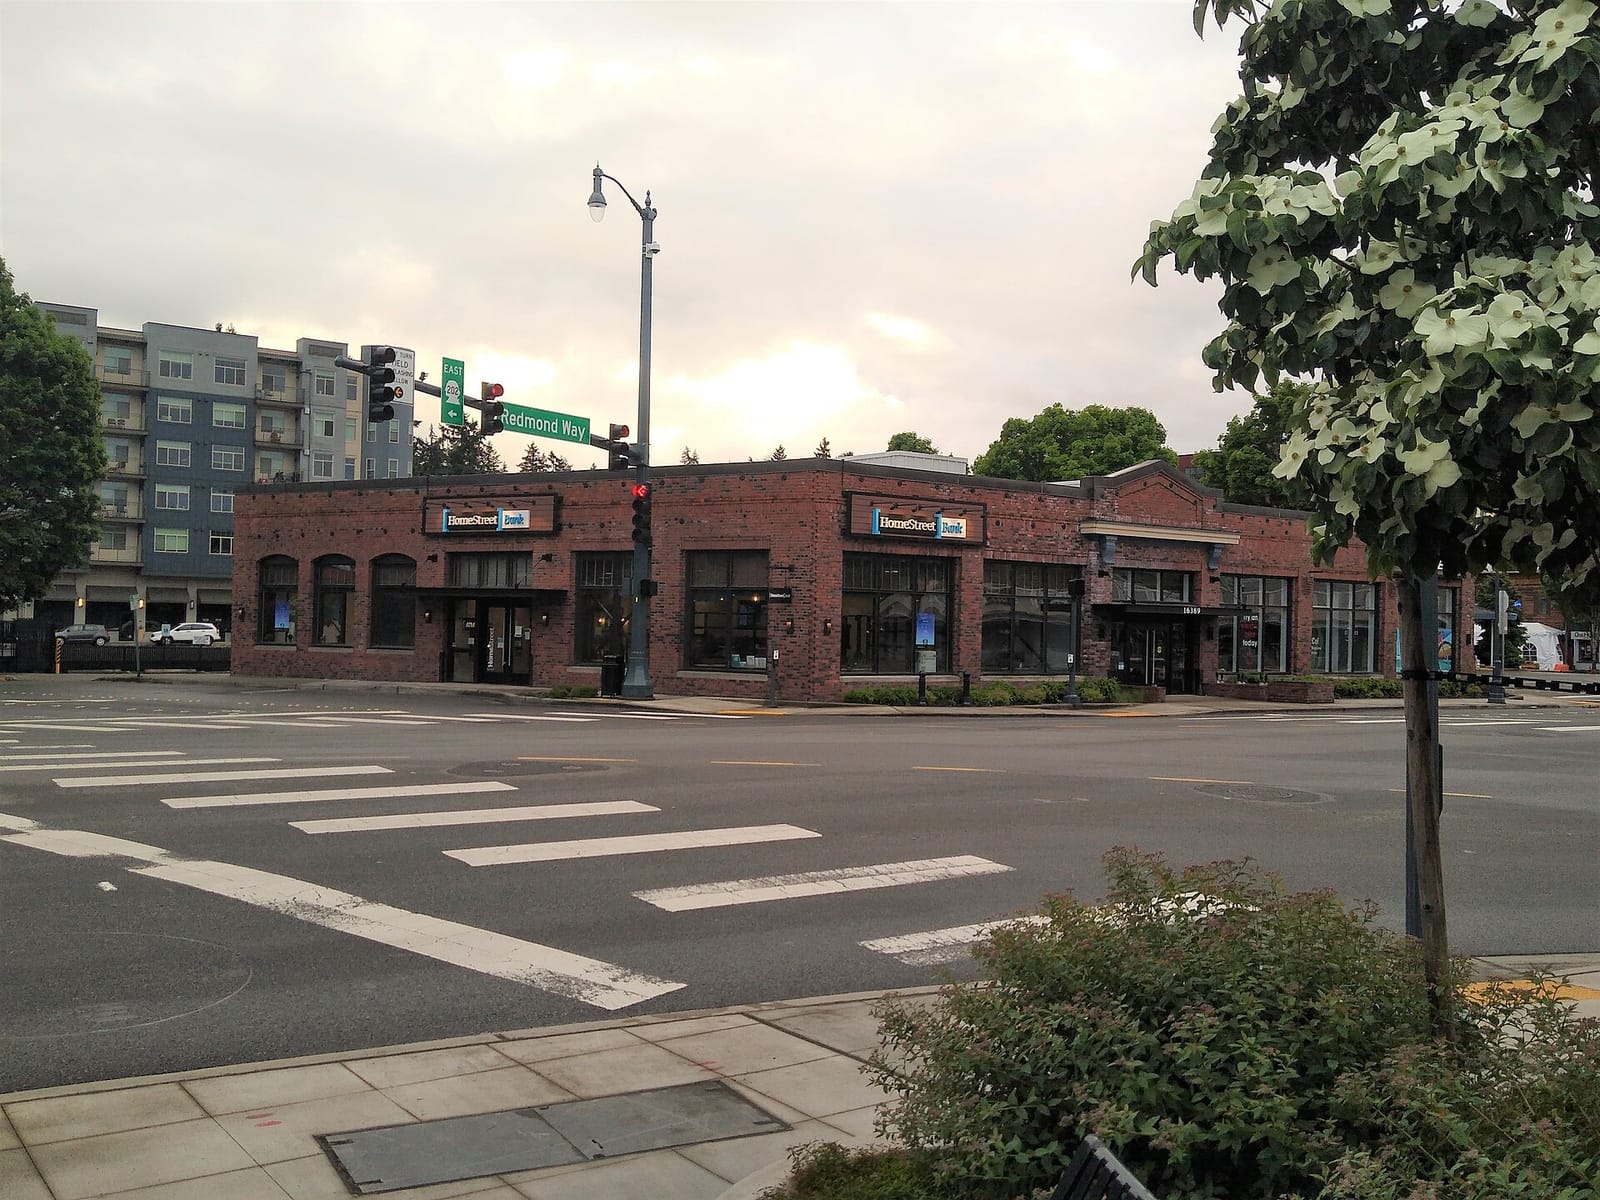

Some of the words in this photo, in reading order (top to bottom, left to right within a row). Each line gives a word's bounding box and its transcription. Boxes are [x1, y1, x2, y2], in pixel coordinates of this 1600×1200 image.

[392, 360, 408, 368] IELD
[443, 364, 463, 375] EAST
[446, 385, 459, 395] 202
[501, 408, 558, 433] Redmond
[562, 419, 586, 442] Way
[448, 515, 498, 526] HomeStreet
[504, 513, 524, 525] Bank
[880, 516, 936, 532] HomeStreet
[942, 521, 963, 534] Bank
[1242, 640, 1258, 648] today
